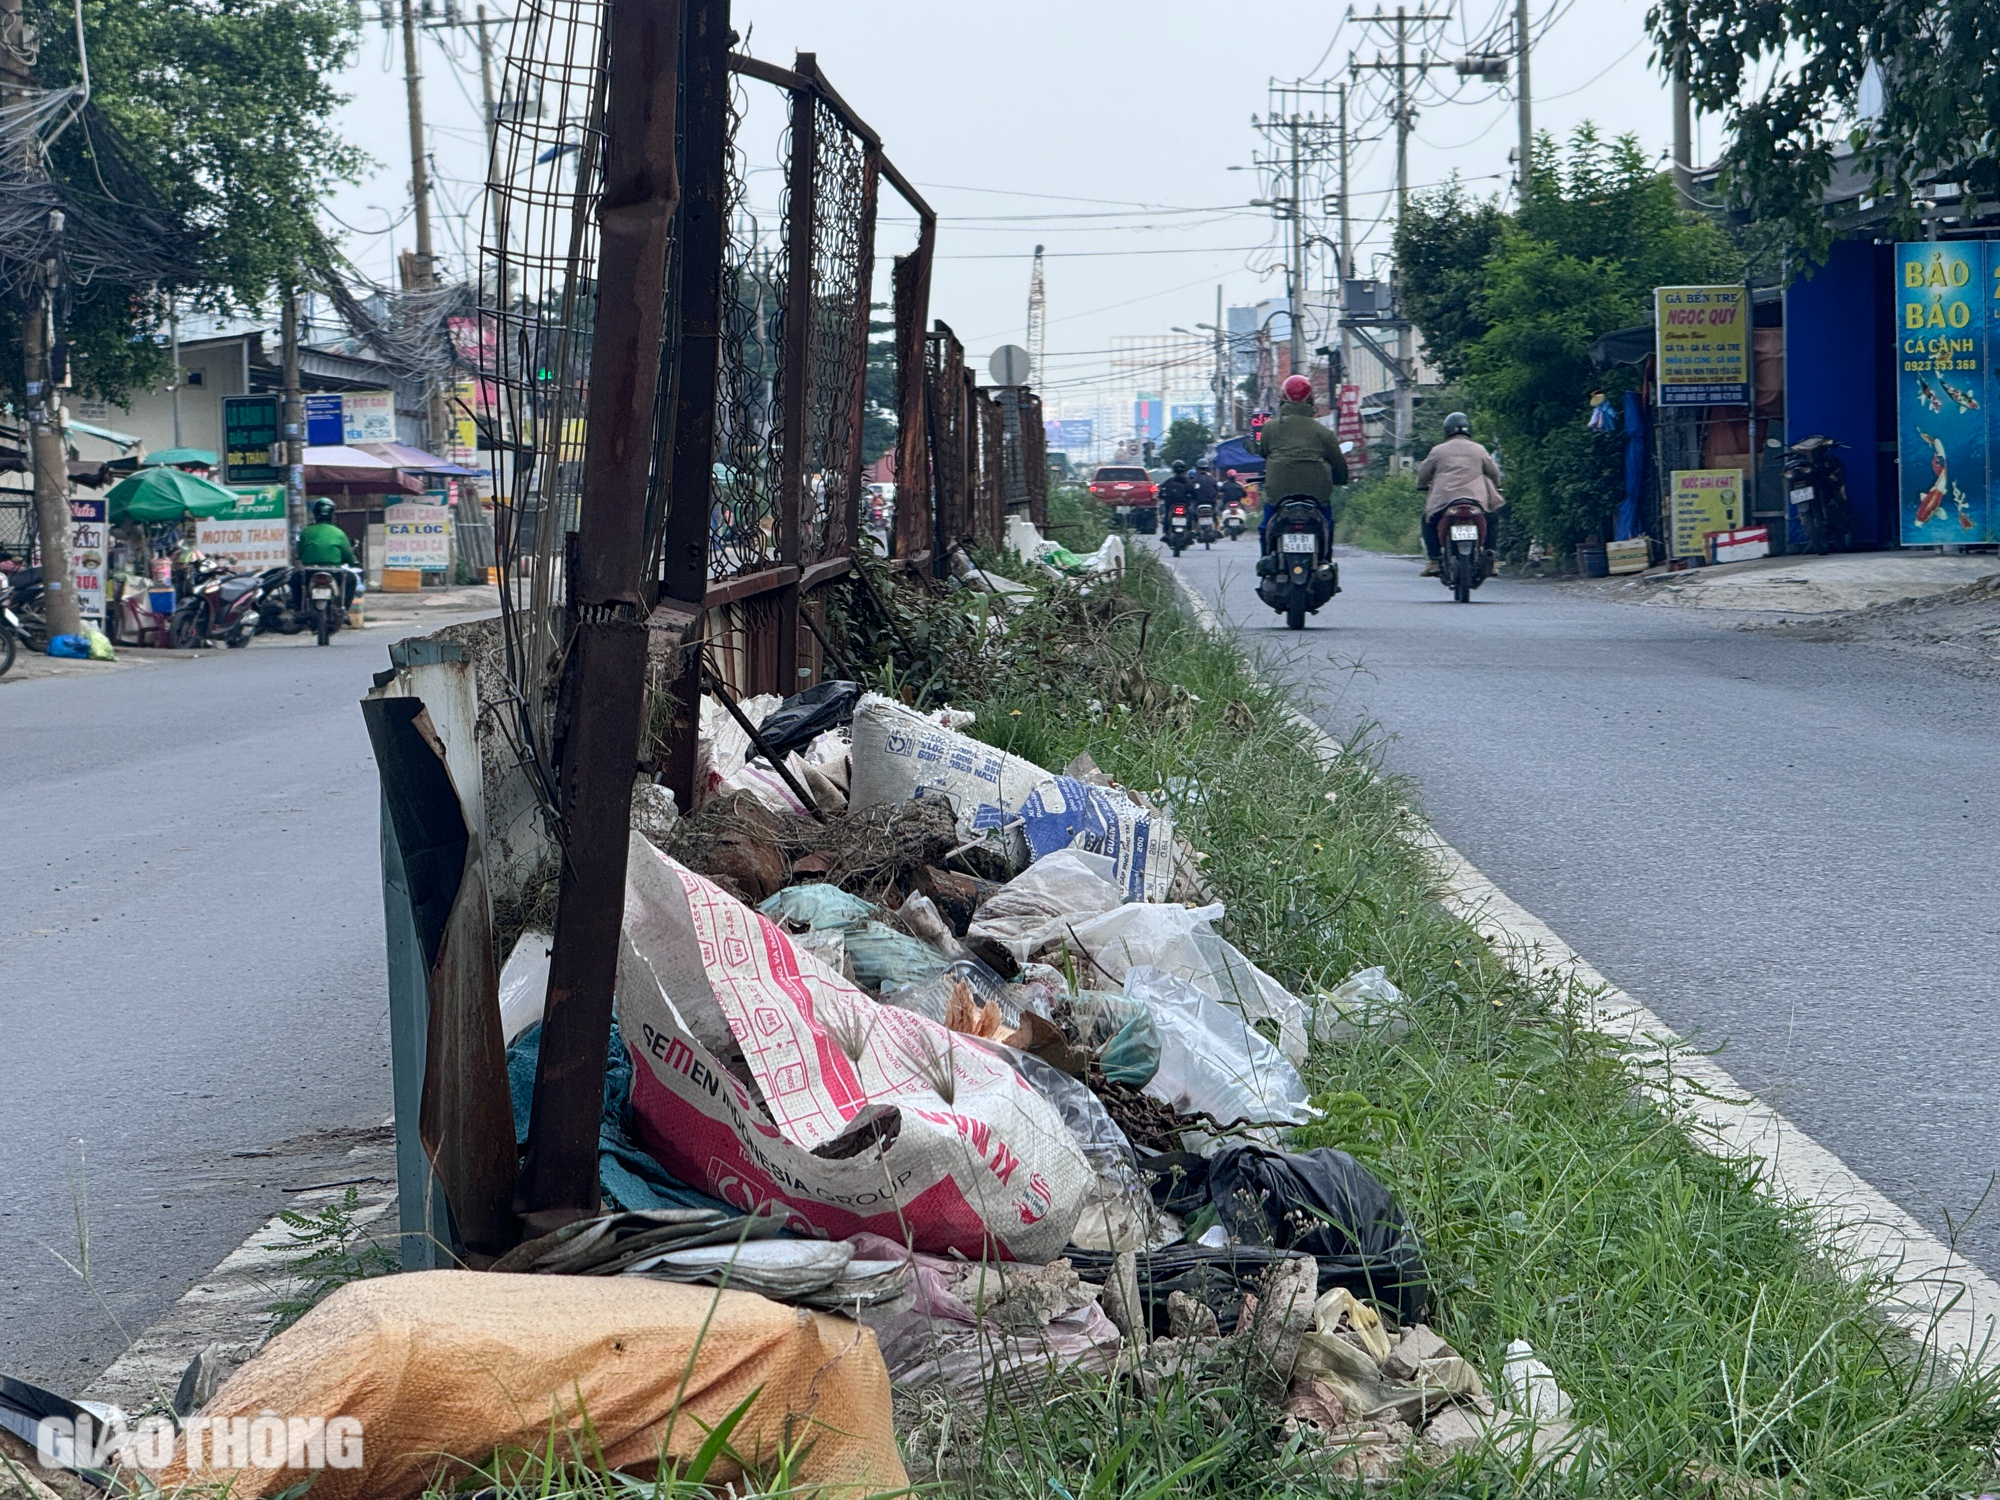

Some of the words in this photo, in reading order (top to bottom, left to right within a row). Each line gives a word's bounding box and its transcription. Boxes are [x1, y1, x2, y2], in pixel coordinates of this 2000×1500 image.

[1905, 251, 1970, 288] BẢO
[1665, 291, 1682, 304] GÀ
[1686, 290, 1711, 303] BẾN
[1714, 293, 1738, 303] TRE
[1666, 308, 1706, 328] NGỌC
[1905, 293, 1970, 329] BẢO
[1904, 336, 1926, 353] CÁ
[1928, 334, 1974, 353] CẢNH
[1904, 361, 1931, 371] 0923
[1956, 360, 1976, 370] 368
[244, 448, 269, 466] THÀN
[247, 505, 275, 513] POINT
[202, 531, 243, 544] MOTOR
[414, 524, 443, 534] LÓC
[917, 749, 942, 762] 2009
[973, 768, 998, 784] TCVN
[983, 765, 1000, 776] ISO
[1136, 836, 1144, 853] 200
[1149, 839, 1158, 856] 280
[785, 1068, 795, 1089] 50kg
[642, 1022, 719, 1097] SEMEN
[816, 1170, 912, 1207] GROUP
